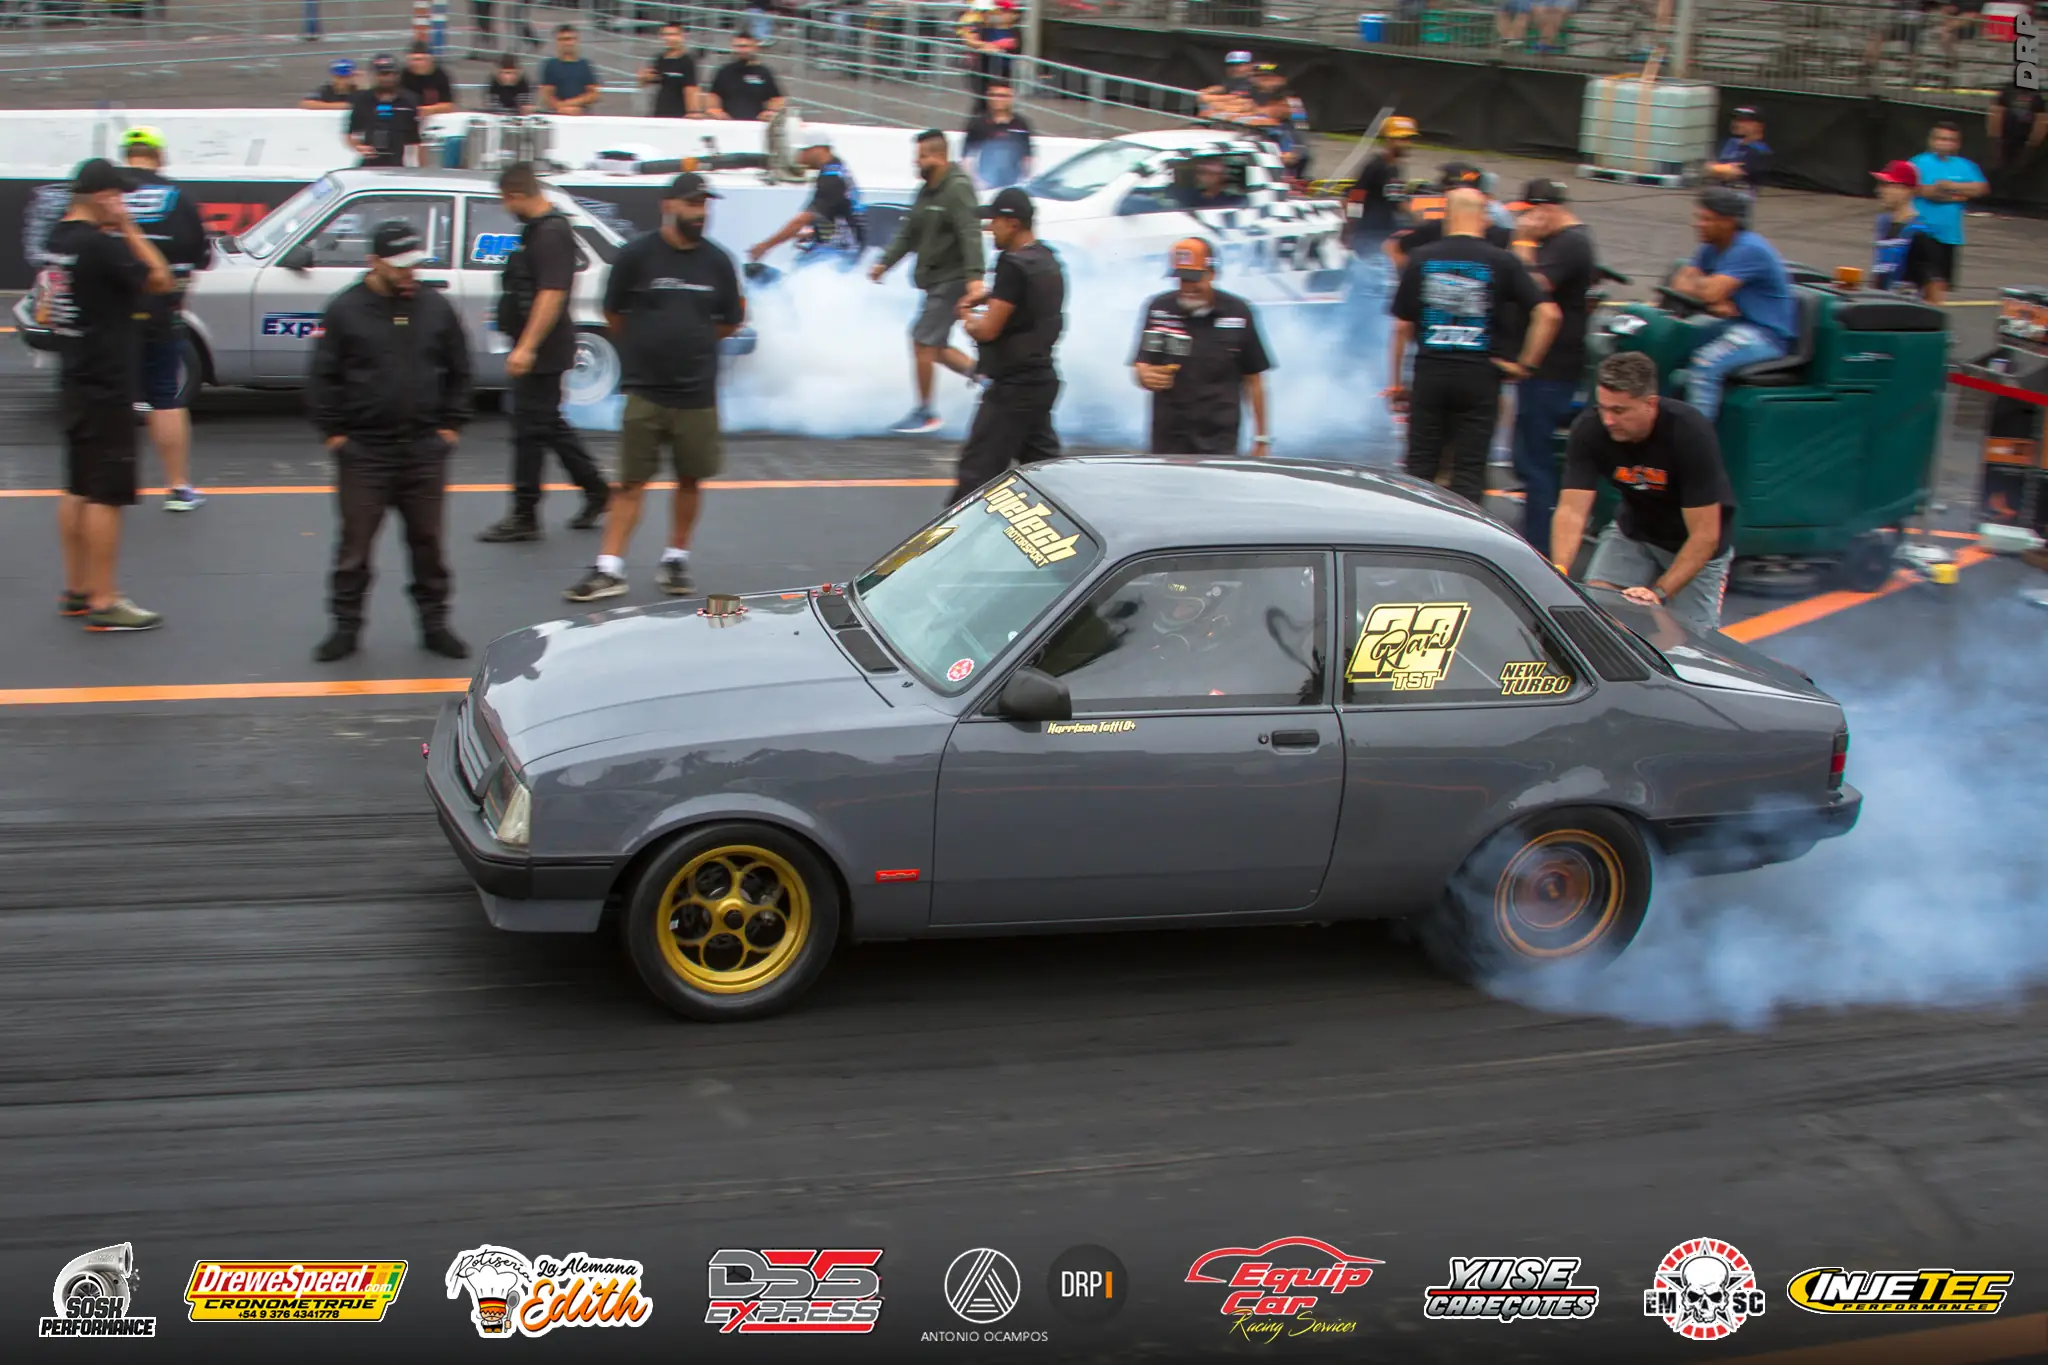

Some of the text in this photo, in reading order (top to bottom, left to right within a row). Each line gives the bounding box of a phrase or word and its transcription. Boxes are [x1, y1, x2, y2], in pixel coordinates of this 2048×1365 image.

[1003, 525, 1050, 568] MOTORSPORT
[1346, 603, 1471, 682] 22
[1392, 671, 1440, 690] TST
[1501, 662, 1547, 680] NEW
[1501, 676, 1573, 695] TURBO
[1047, 721, 1098, 734] Harrison
